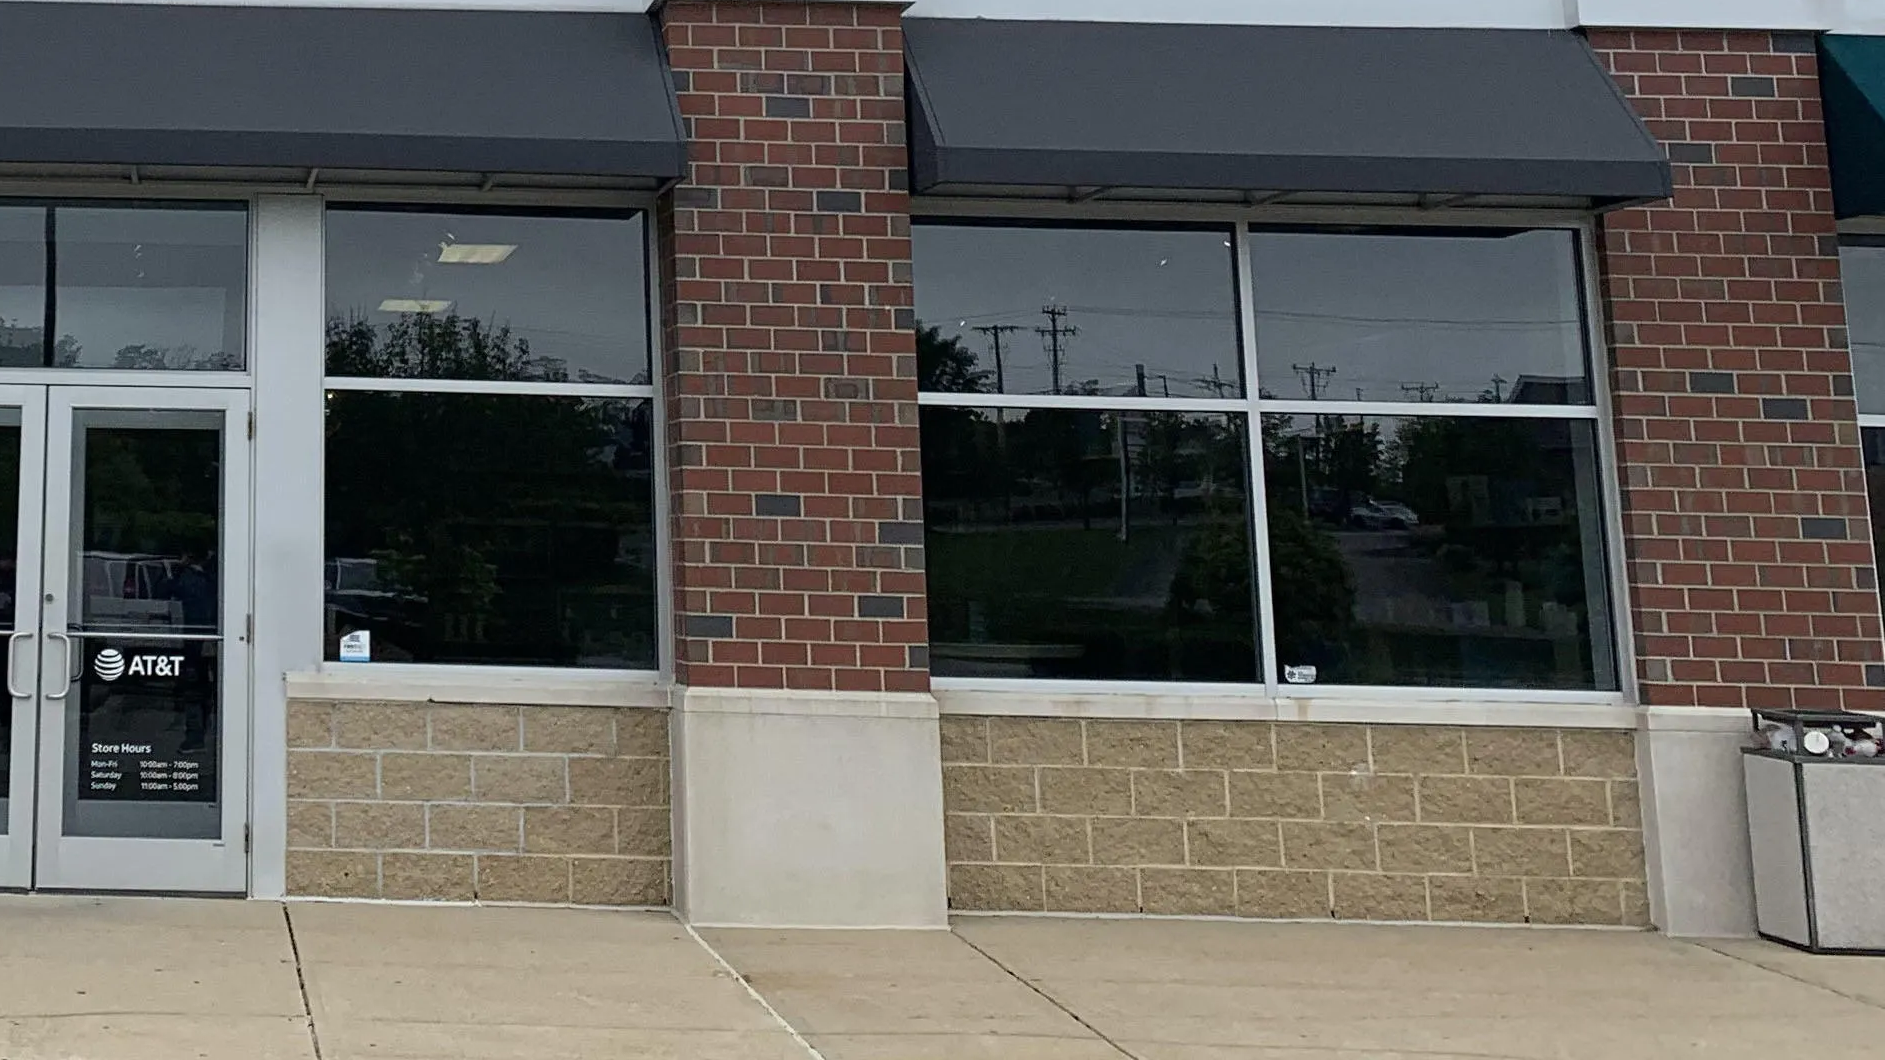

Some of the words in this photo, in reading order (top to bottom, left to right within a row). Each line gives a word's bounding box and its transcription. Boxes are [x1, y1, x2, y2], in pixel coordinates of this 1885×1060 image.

[128, 655, 185, 676] AT&T
[91, 743, 120, 754] Store
[121, 743, 152, 754] Hours
[91, 760, 118, 768] Mon-Fri
[91, 771, 122, 780] Saturday
[91, 781, 117, 791] Sunday
